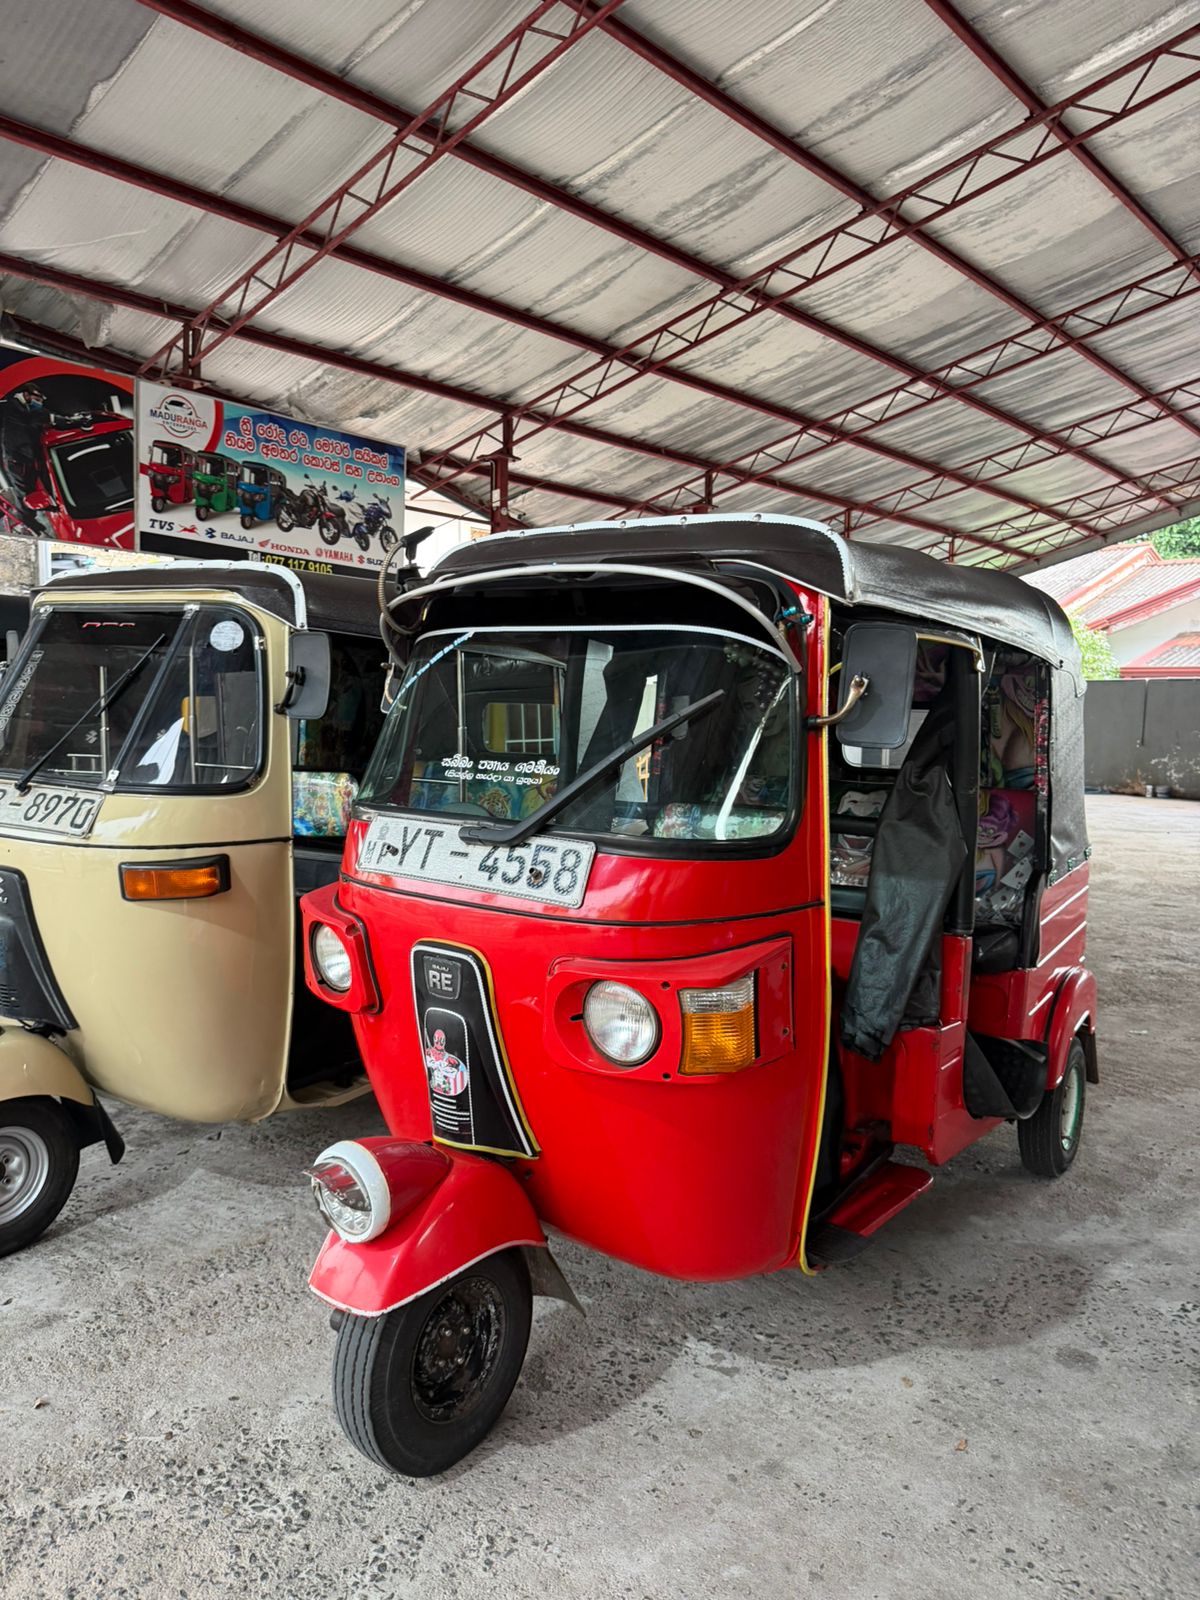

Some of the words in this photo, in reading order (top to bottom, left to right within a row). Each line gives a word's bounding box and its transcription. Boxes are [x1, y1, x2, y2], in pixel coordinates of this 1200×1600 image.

[149, 408, 208, 430] MADURANGA
[257, 424, 287, 445] රෝද
[315, 439, 350, 458] මෝටර්
[354, 448, 388, 469] සයිකල්
[225, 431, 255, 453] නියම
[261, 443, 298, 463] අමතර
[303, 454, 340, 472] කොටස්
[344, 464, 363, 477] සහ
[367, 470, 400, 487] උපාංග
[149, 519, 175, 531] TVS
[221, 532, 254, 544] BAJAJ
[270, 542, 310, 556] HONDA
[324, 550, 353, 563] YAMAHA
[287, 559, 306, 571] 117
[309, 561, 333, 575] 9105
[366, 557, 398, 569] SUZKI
[441, 753, 474, 769] සබ්බං
[429, 969, 454, 992] RE
